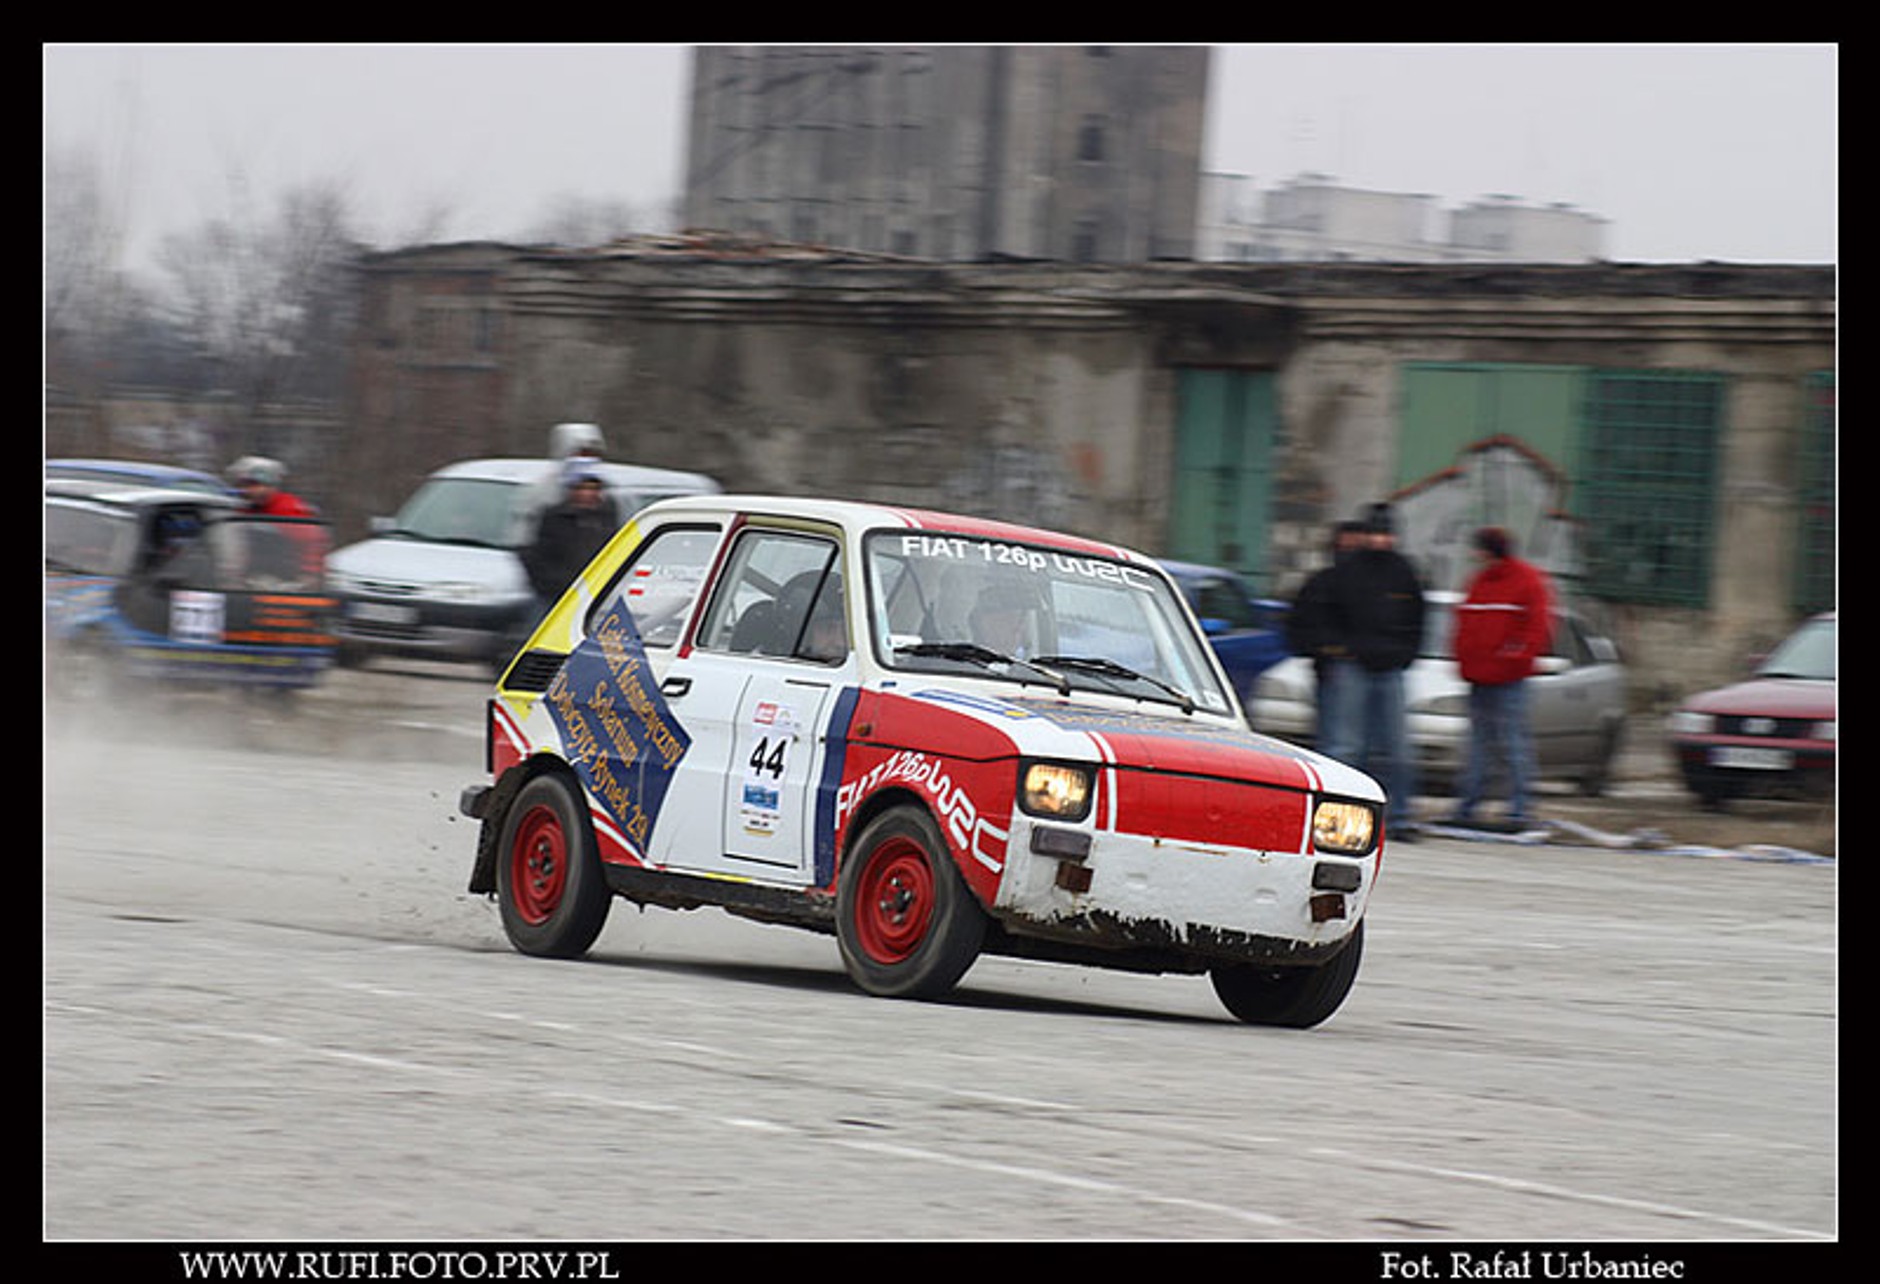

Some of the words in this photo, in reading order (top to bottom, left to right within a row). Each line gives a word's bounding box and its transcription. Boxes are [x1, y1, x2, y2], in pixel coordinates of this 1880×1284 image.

[901, 535, 970, 559] FIAT
[977, 542, 1047, 571] 126p
[1052, 553, 1156, 592] WRC
[589, 679, 639, 768] Solarium
[750, 736, 787, 780] 44
[589, 750, 631, 821] Rynek
[880, 750, 932, 783] 126p
[926, 760, 1009, 873] WRC
